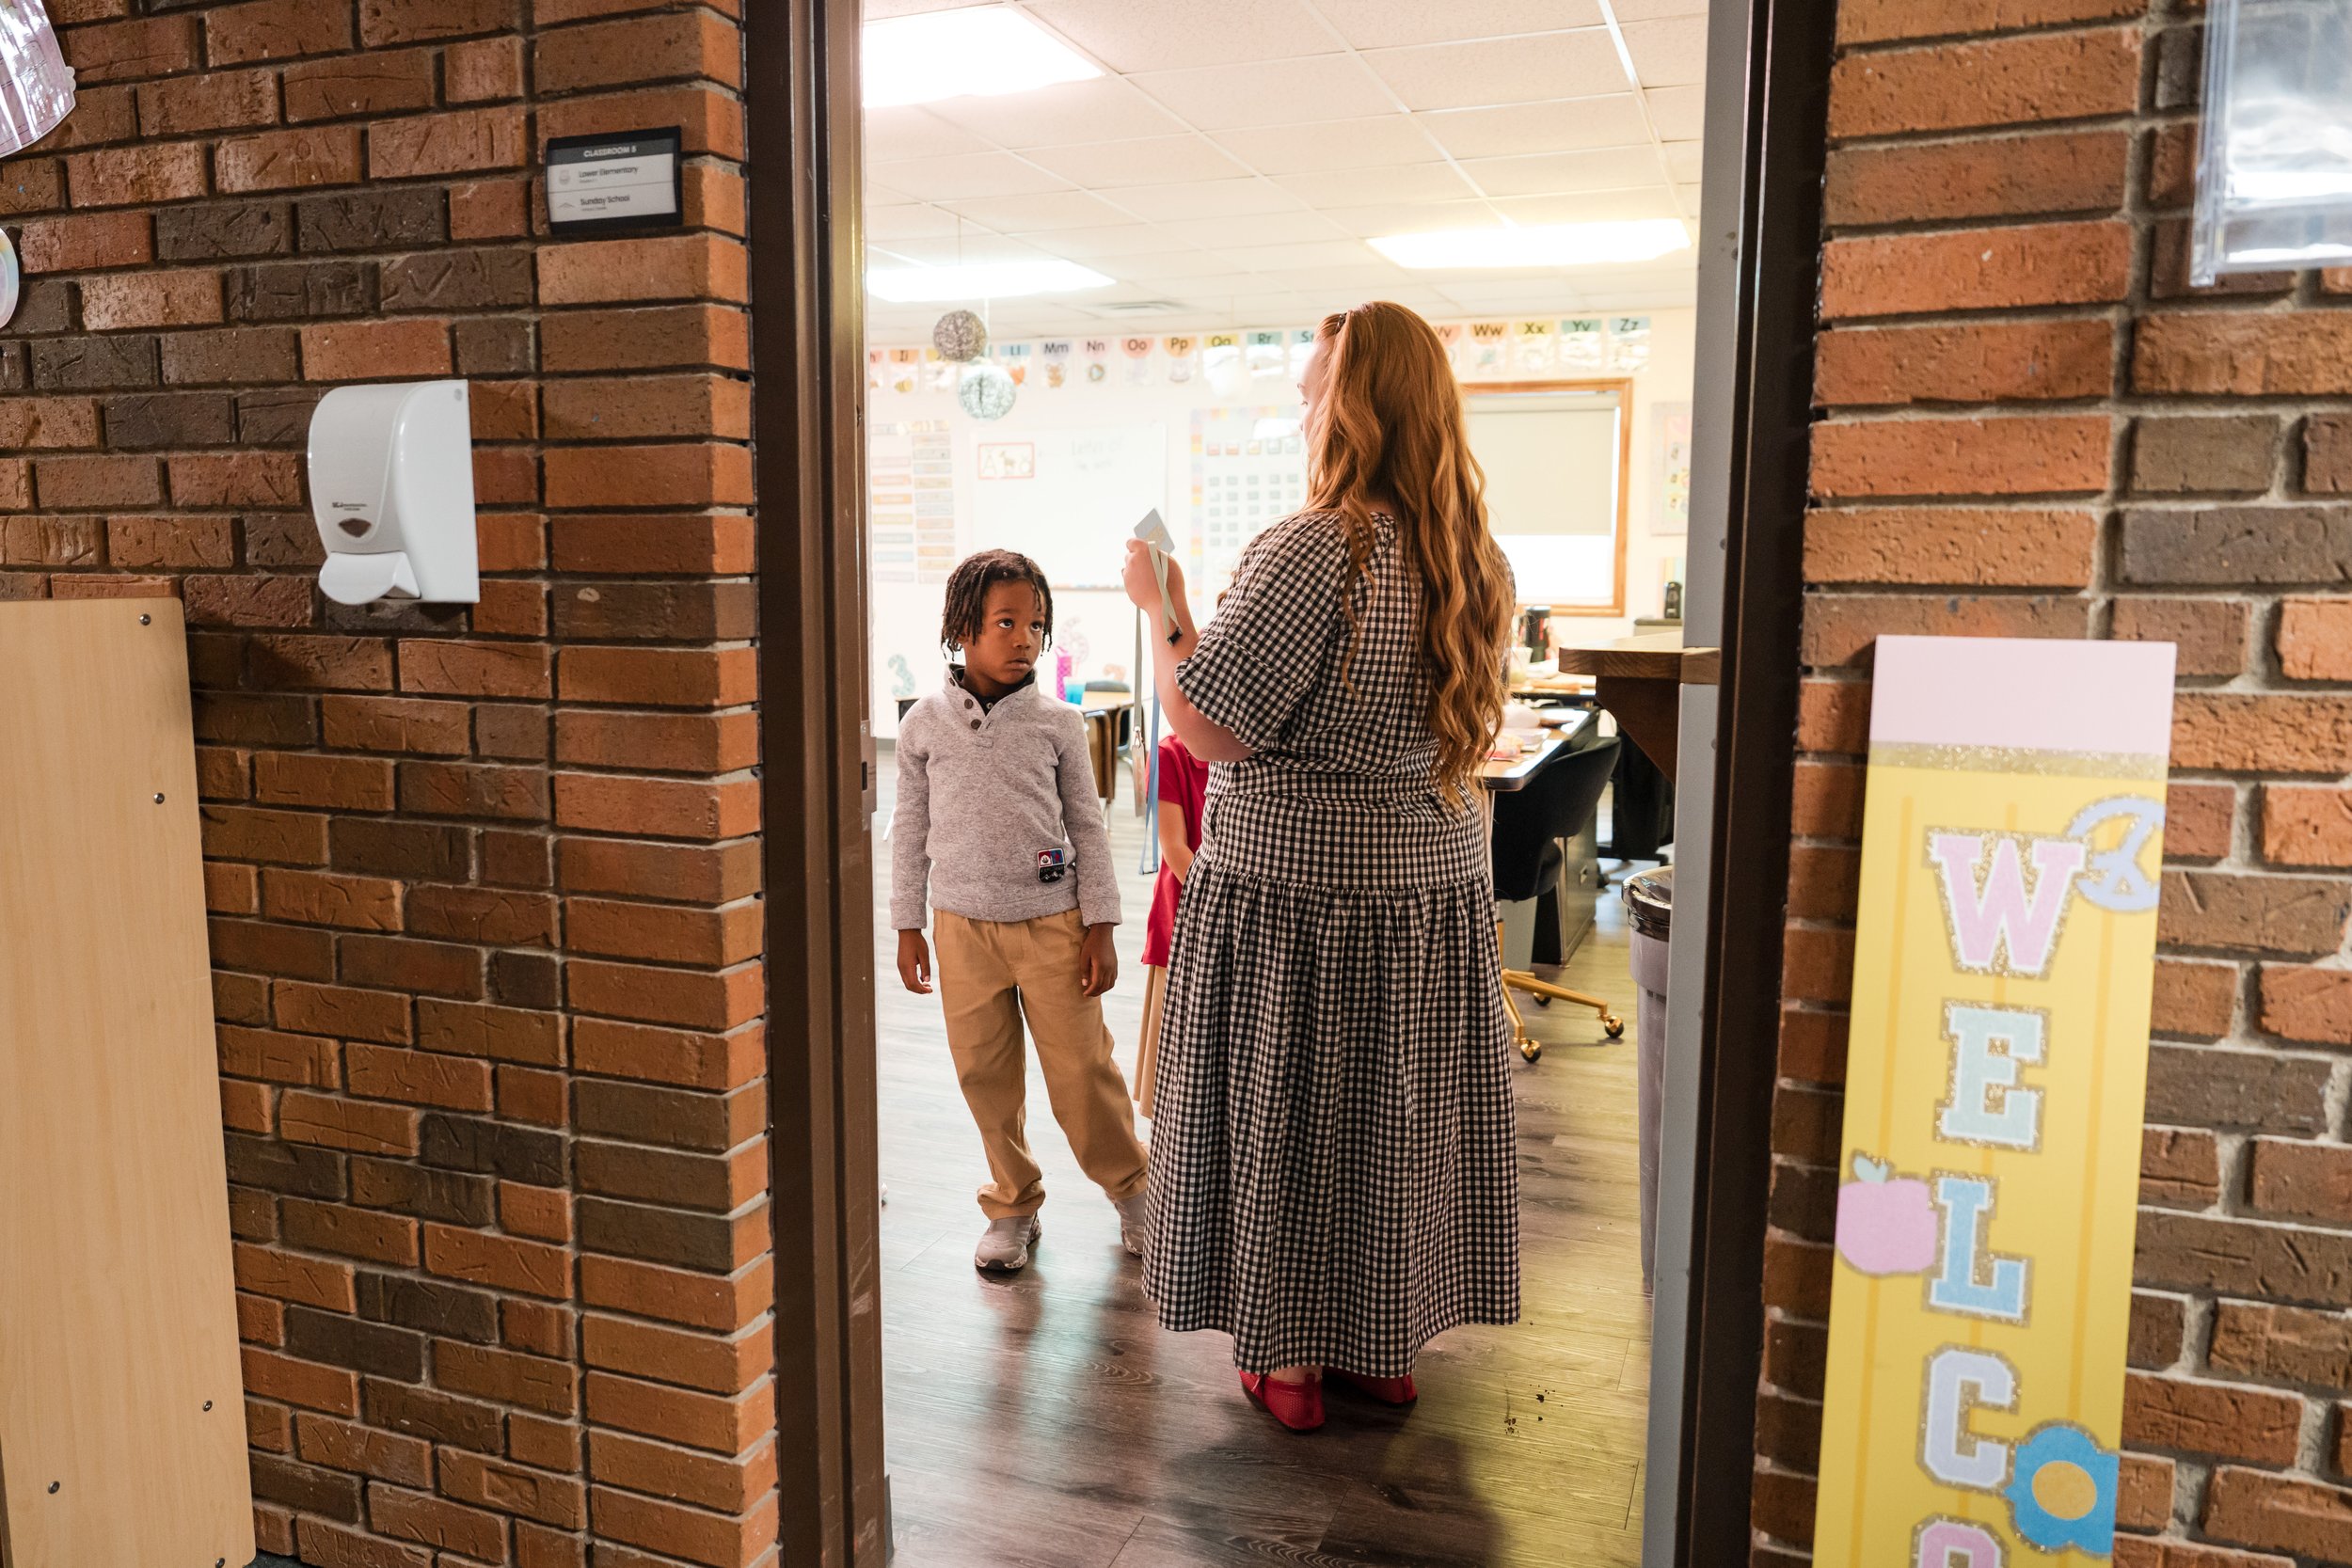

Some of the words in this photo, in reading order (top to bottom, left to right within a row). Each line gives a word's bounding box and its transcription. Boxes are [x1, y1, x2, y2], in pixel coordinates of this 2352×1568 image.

[583, 146, 630, 158] CLASSROOM
[579, 167, 598, 179] Lower
[599, 165, 639, 176] Elementary
[580, 196, 607, 207] Sunday
[607, 194, 630, 203] School
[1044, 341, 1069, 355] Mm
[1087, 341, 1105, 352] Nn
[1128, 339, 1148, 351] Oo
[1170, 337, 1188, 352] Pp
[1258, 333, 1272, 344] Rr
[1473, 325, 1503, 337] Ww
[1524, 322, 1545, 334] Xx
[1620, 318, 1640, 331] Zz
